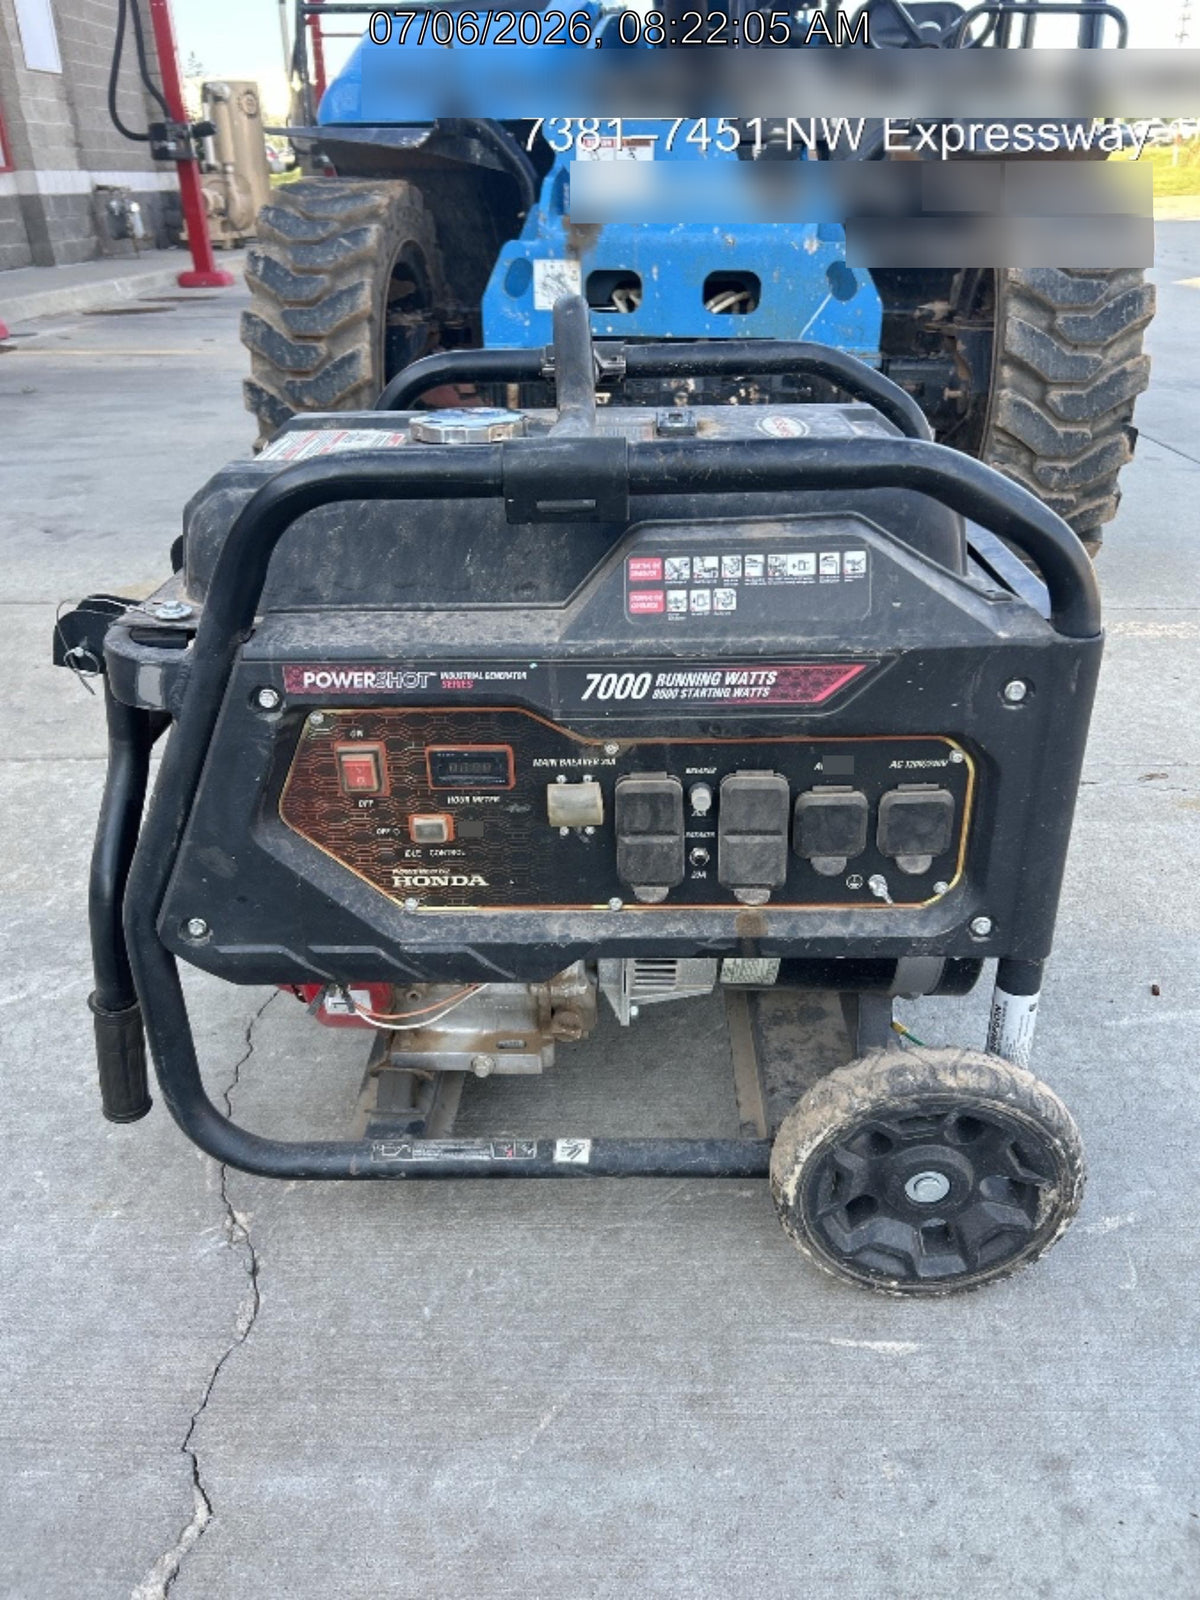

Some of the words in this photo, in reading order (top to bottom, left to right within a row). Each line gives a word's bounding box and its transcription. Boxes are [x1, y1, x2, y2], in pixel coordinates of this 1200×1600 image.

[655, 673, 721, 687] RUNNING
[724, 671, 778, 686] WATTS
[581, 672, 652, 701] 7000
[680, 687, 730, 699] STARTING
[732, 686, 770, 698] WATTS
[392, 875, 490, 887] HONDA
